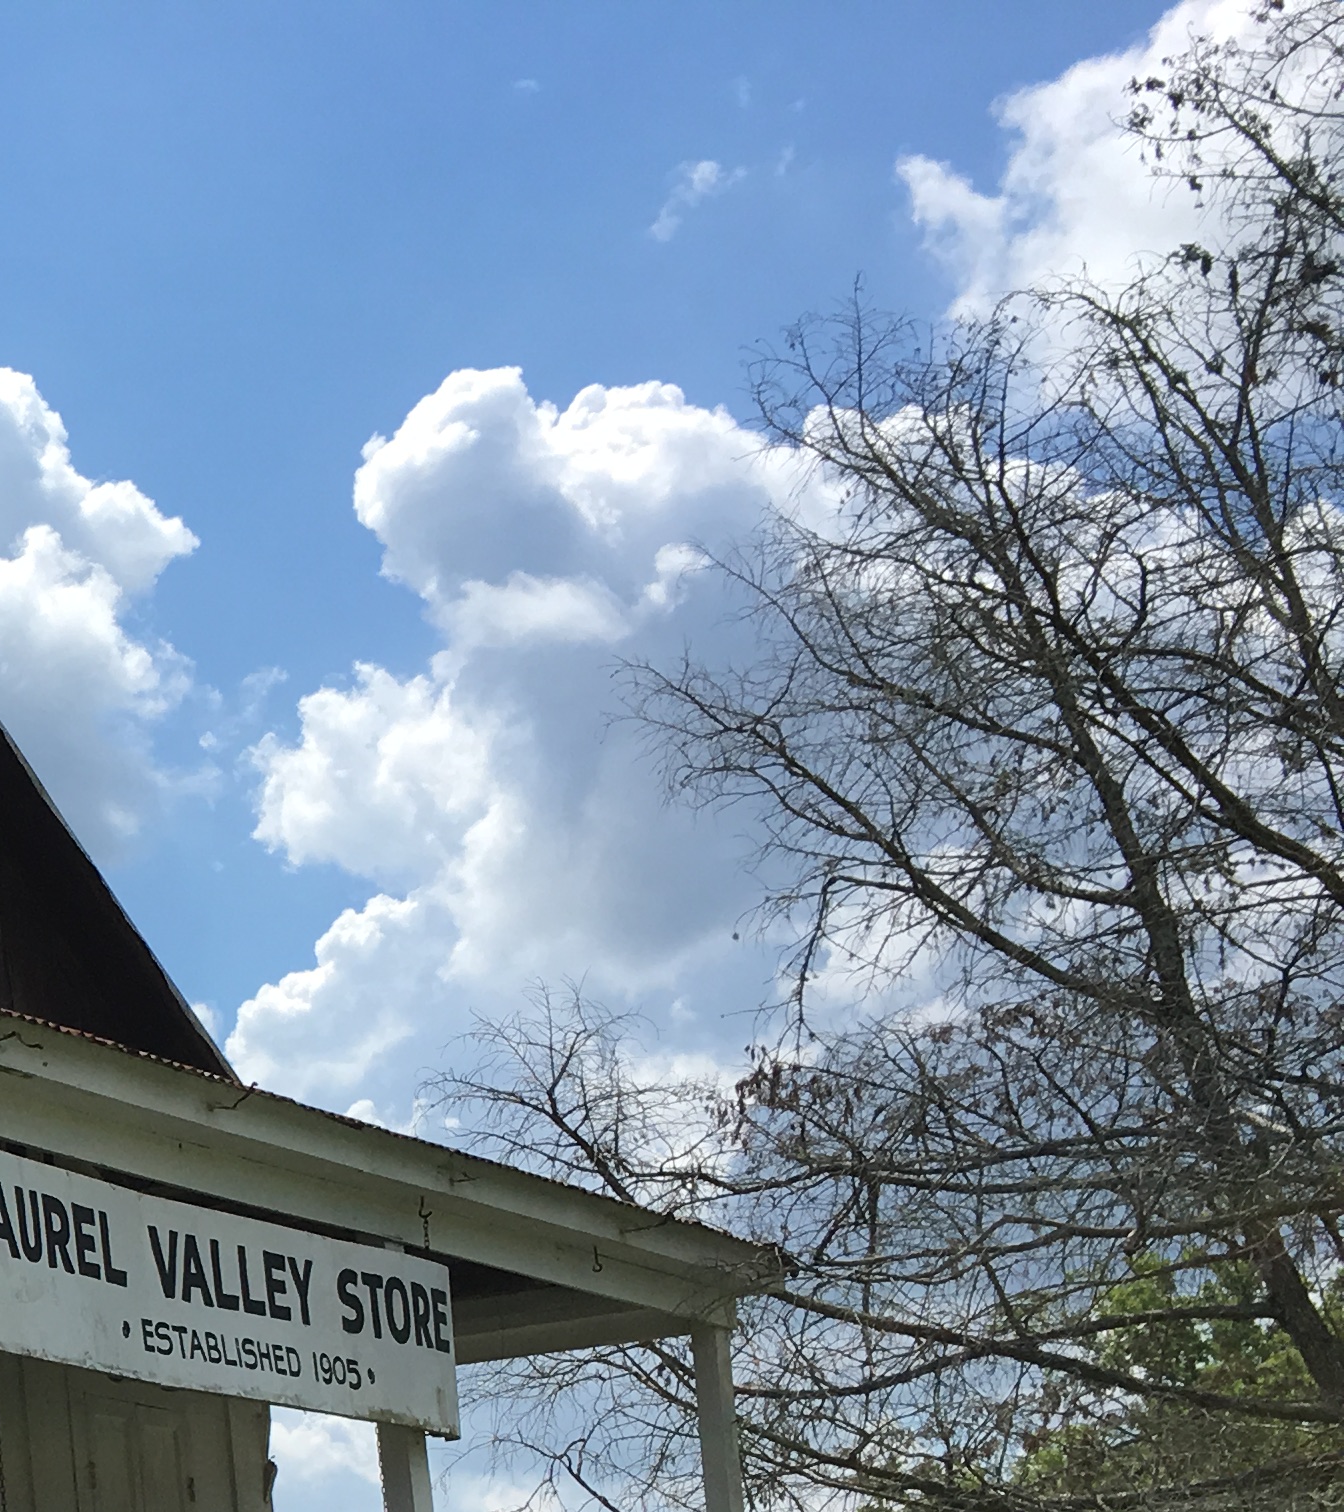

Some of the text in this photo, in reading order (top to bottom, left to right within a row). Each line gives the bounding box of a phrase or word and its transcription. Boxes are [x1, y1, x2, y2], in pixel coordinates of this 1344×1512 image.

[147, 1225, 314, 1327] VALLEY
[336, 1267, 452, 1354] STORE
[142, 1318, 363, 1392] ESTABLISHED 1905
